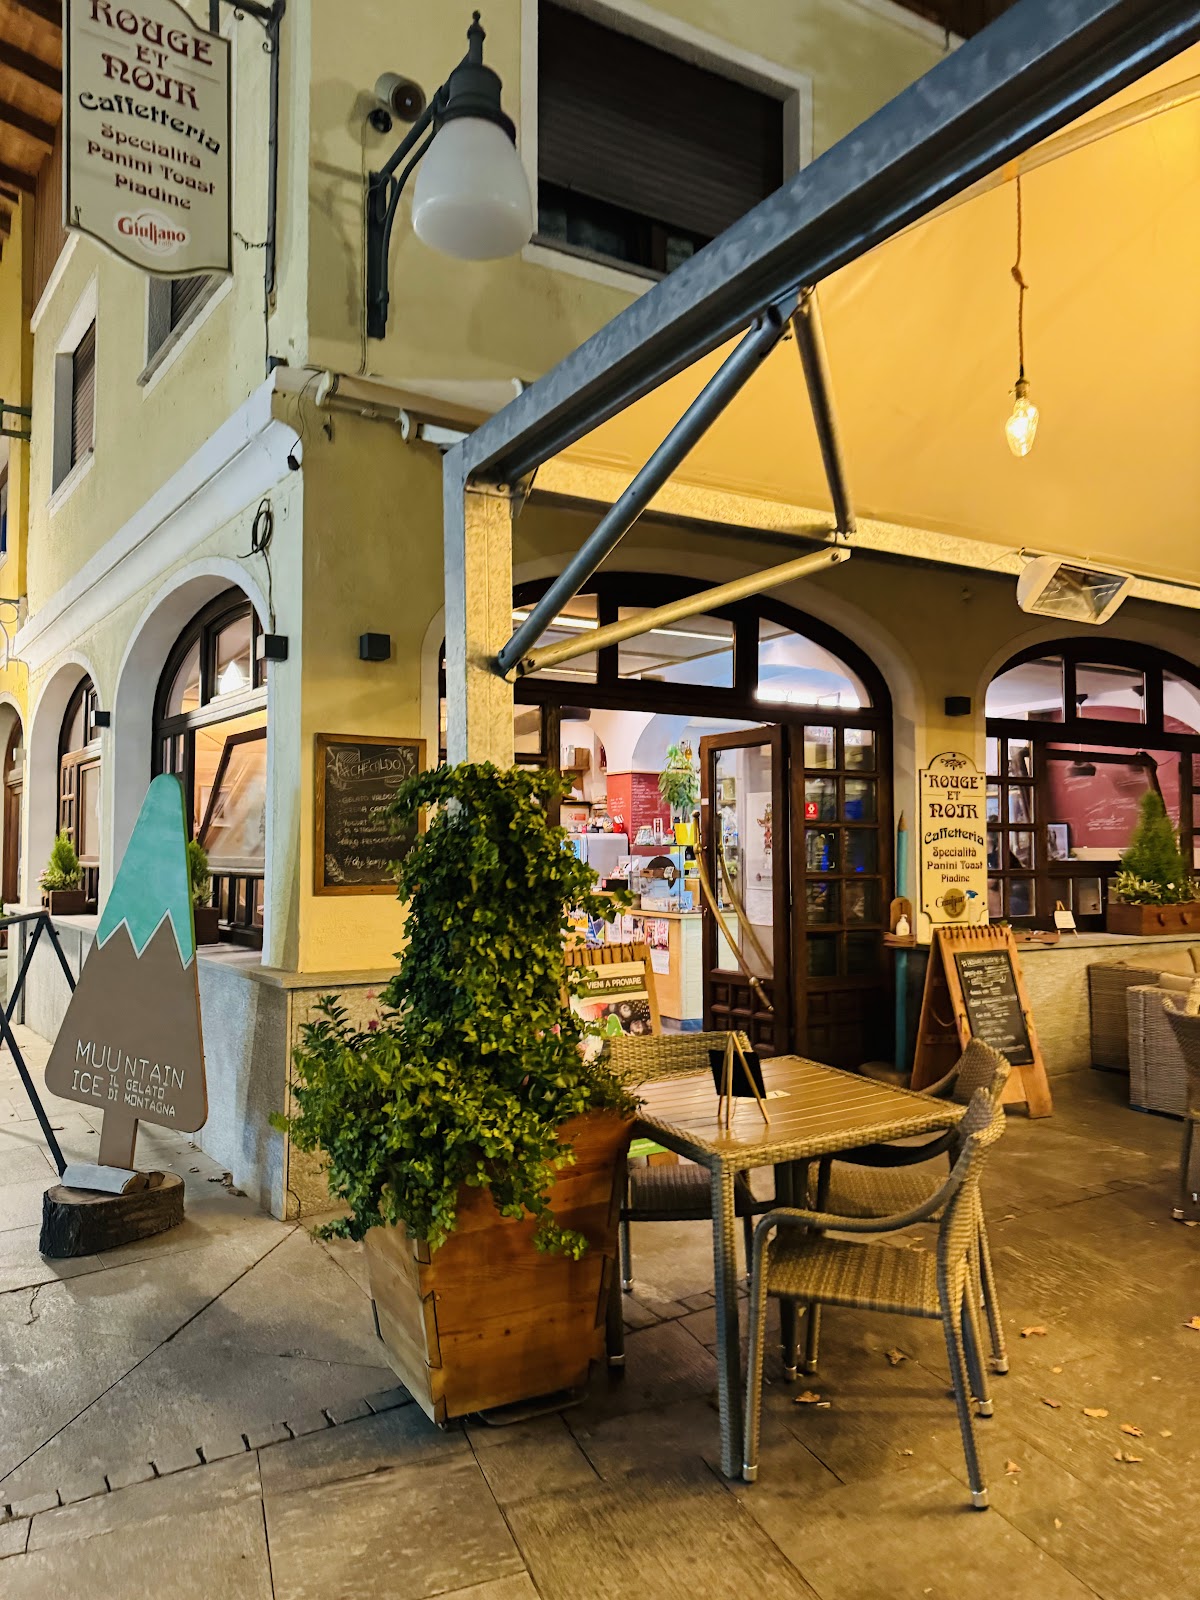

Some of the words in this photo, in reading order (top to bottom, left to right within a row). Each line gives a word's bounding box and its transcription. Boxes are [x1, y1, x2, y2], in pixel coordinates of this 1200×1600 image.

[90, 0, 213, 66] ROUGE
[136, 44, 169, 69] ET
[101, 52, 200, 110] NOIR
[79, 91, 221, 155] Caffetteria
[87, 139, 153, 174] Panini
[159, 163, 216, 195] Toast
[114, 172, 191, 210] Piadine
[929, 774, 979, 789] ROUGE
[947, 790, 961, 800] ET
[928, 803, 979, 819] NOIR
[924, 827, 984, 846] Caffetteria
[926, 860, 958, 870] Panini
[959, 860, 983, 870] Toast
[941, 873, 970, 883] Piadine
[586, 980, 604, 990] VIENI
[605, 979, 612, 988] A
[611, 977, 642, 987] PROVARE
[74, 1038, 185, 1090] MUUNTAIN
[71, 1069, 104, 1098] ICE
[109, 1074, 120, 1088] IL
[125, 1078, 165, 1100] GELATO
[107, 1087, 118, 1101] DI
[123, 1093, 176, 1117] MONTAGNA
